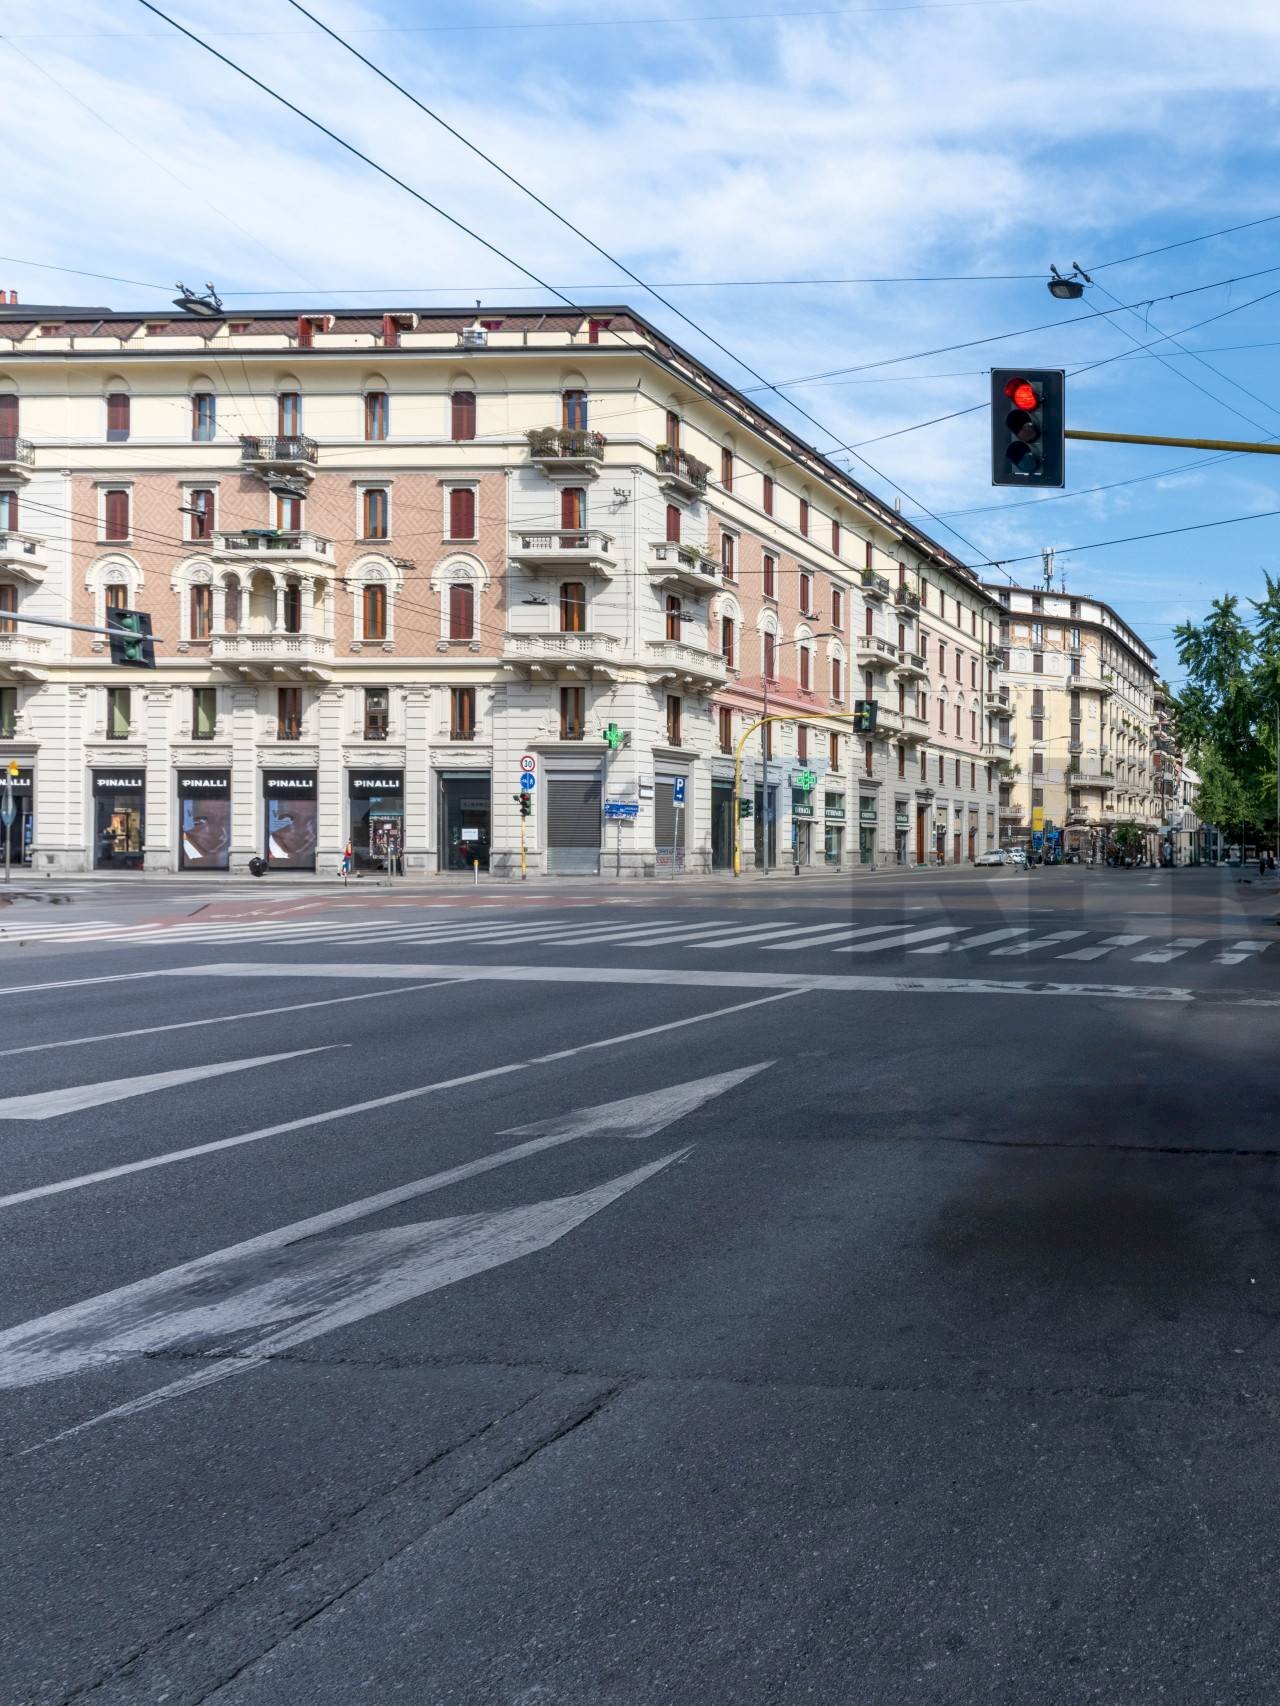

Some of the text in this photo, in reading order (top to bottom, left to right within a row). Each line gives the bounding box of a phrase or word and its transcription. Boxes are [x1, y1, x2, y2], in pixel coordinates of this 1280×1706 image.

[524, 759, 533, 768] 30
[97, 779, 142, 787] PINALLI
[181, 779, 227, 787] PINALLI
[677, 778, 684, 791] P
